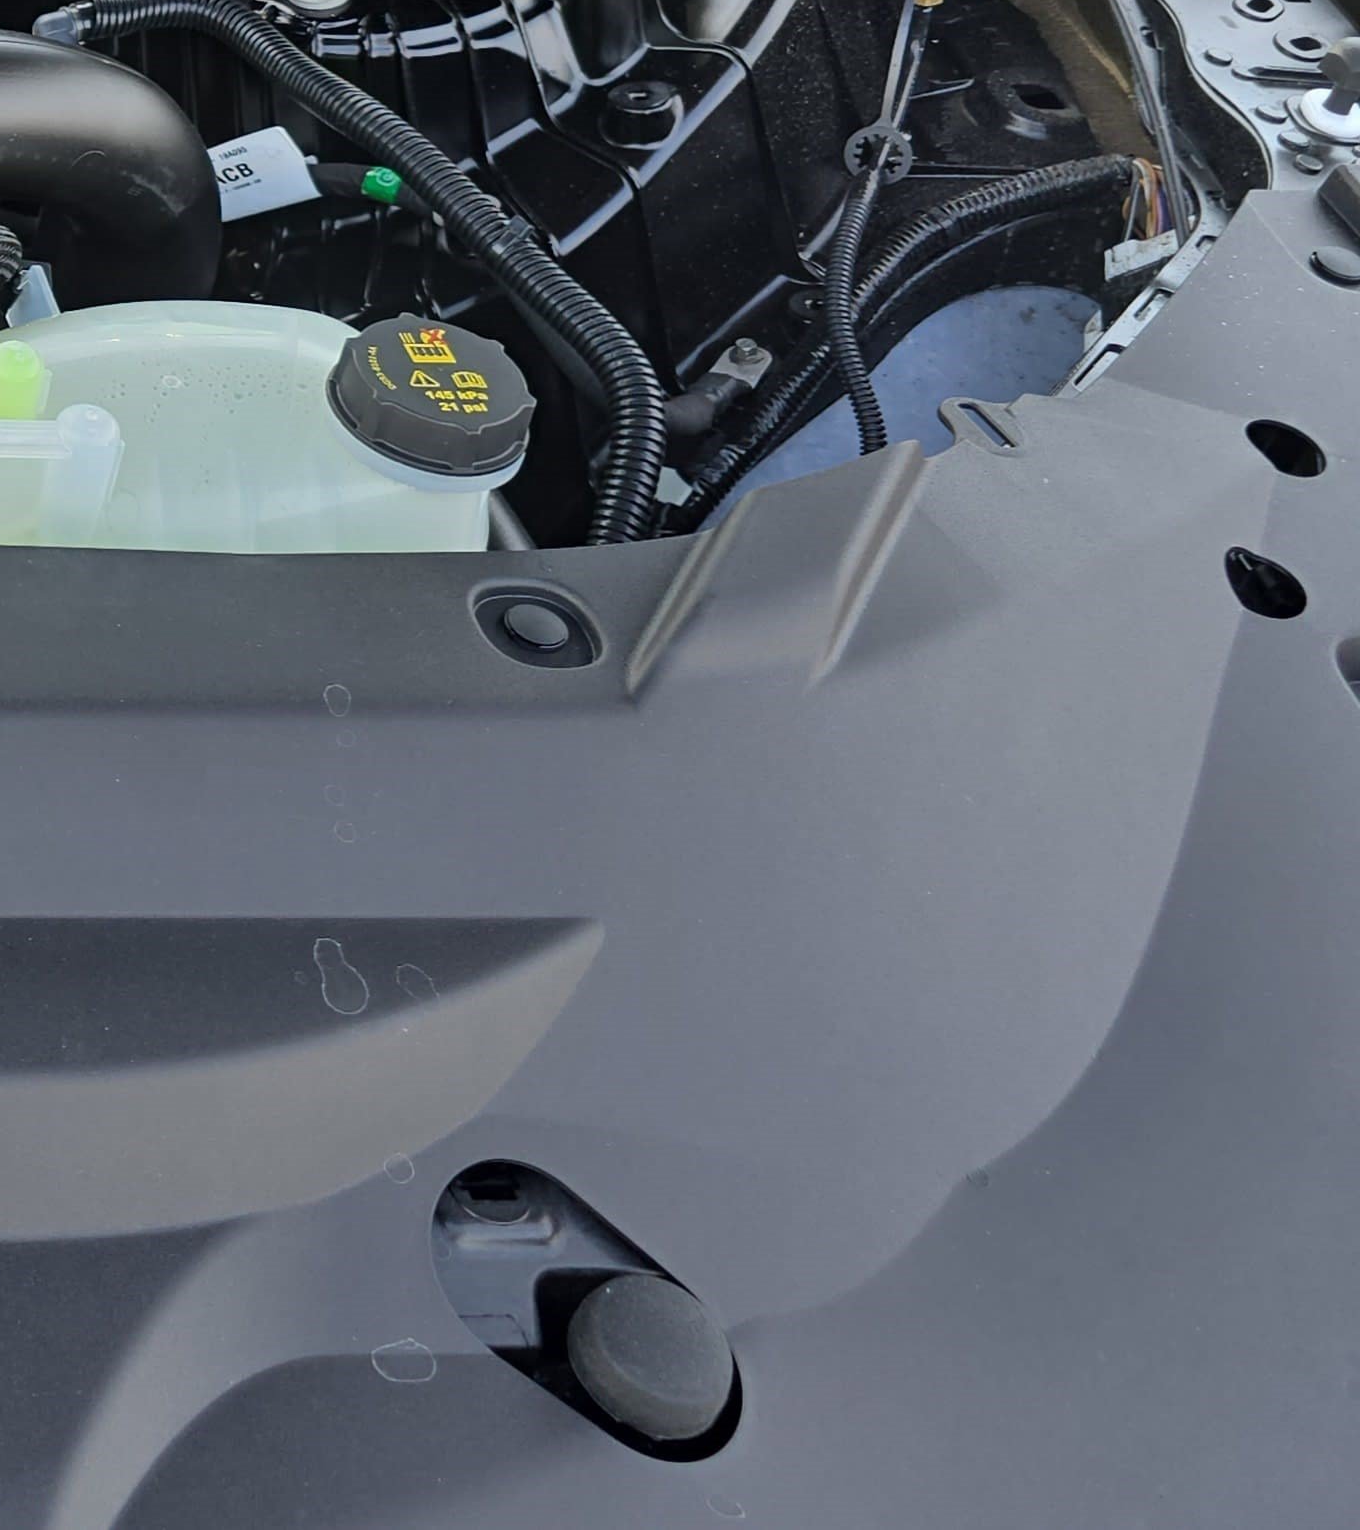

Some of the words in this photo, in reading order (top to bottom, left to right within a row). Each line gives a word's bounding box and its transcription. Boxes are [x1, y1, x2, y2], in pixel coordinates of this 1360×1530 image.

[215, 163, 254, 184] CB
[425, 390, 455, 400] 145
[456, 390, 489, 400] kPa
[438, 402, 460, 412] 21
[462, 402, 489, 413] psi
